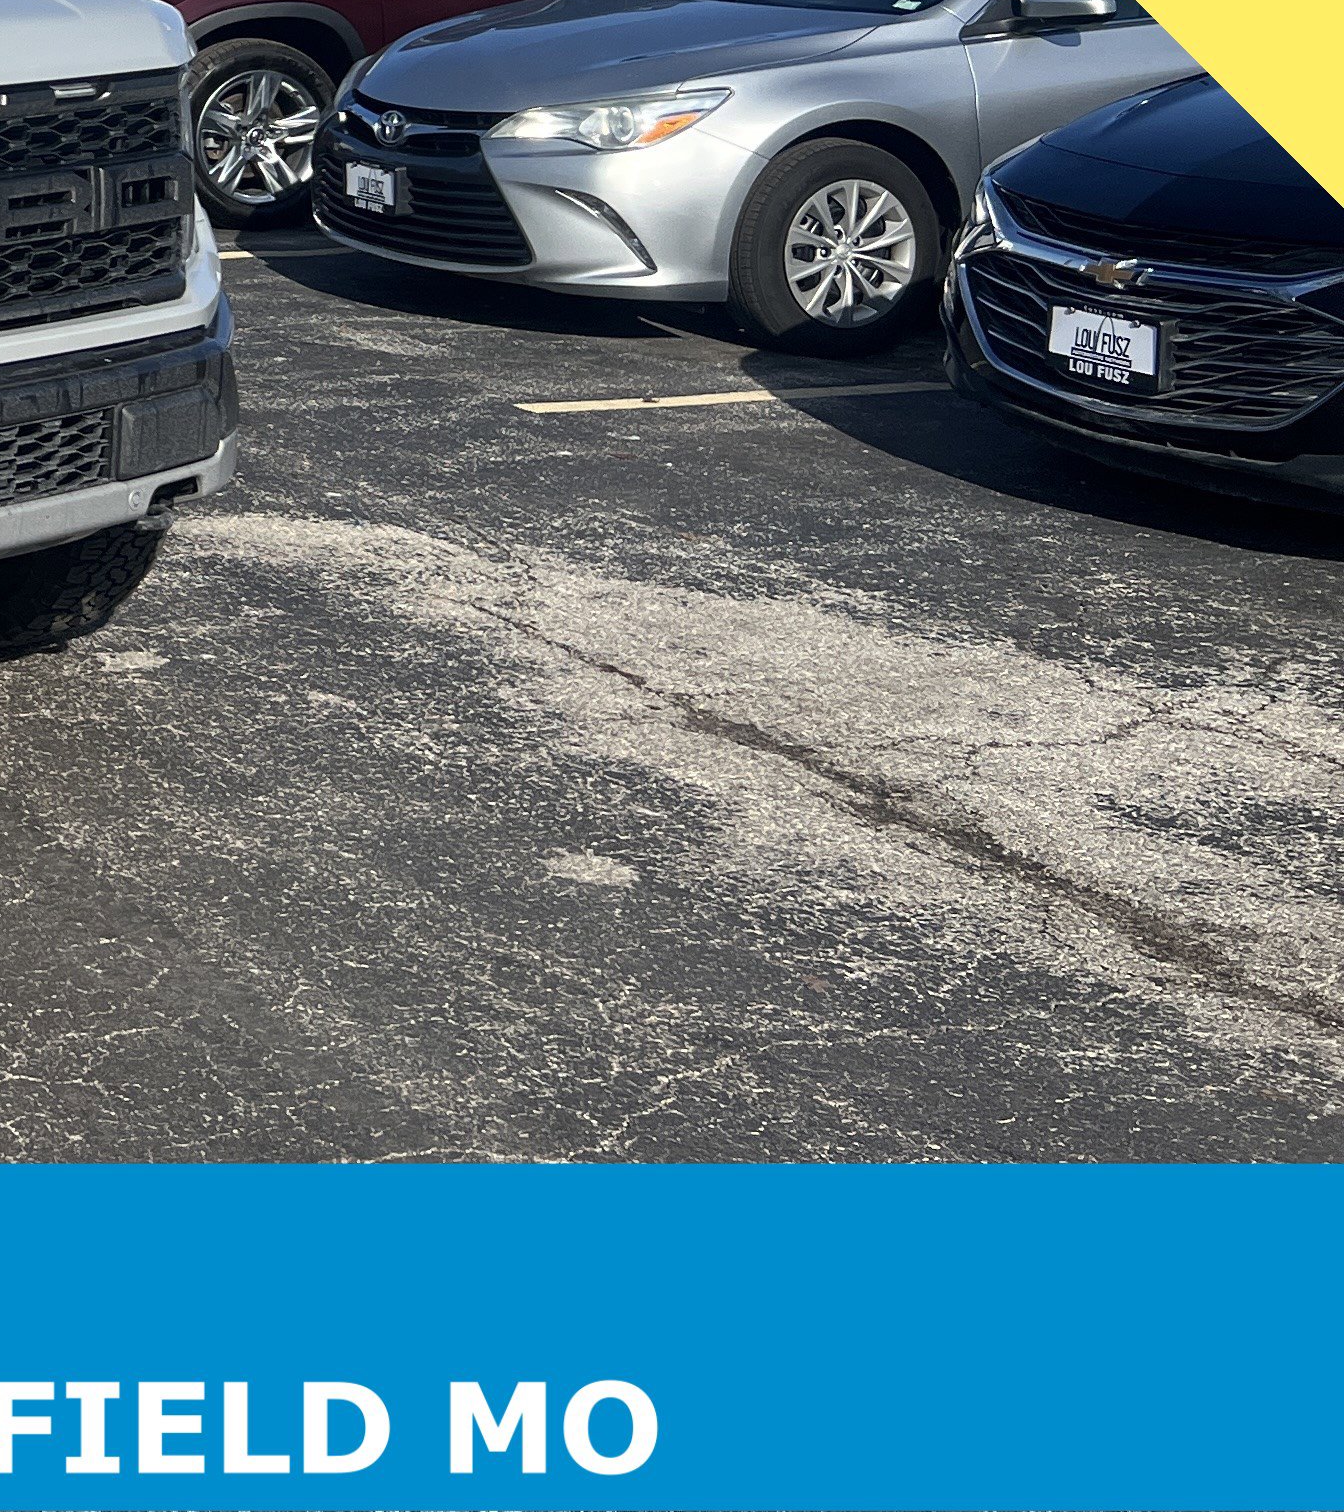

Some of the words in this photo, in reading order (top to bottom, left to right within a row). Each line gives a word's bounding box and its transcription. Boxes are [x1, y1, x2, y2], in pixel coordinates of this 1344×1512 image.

[1075, 326, 1098, 352] LOU
[1101, 333, 1131, 358] FUSZ
[1069, 359, 1093, 376] LOU
[1097, 365, 1130, 385] FUSZ
